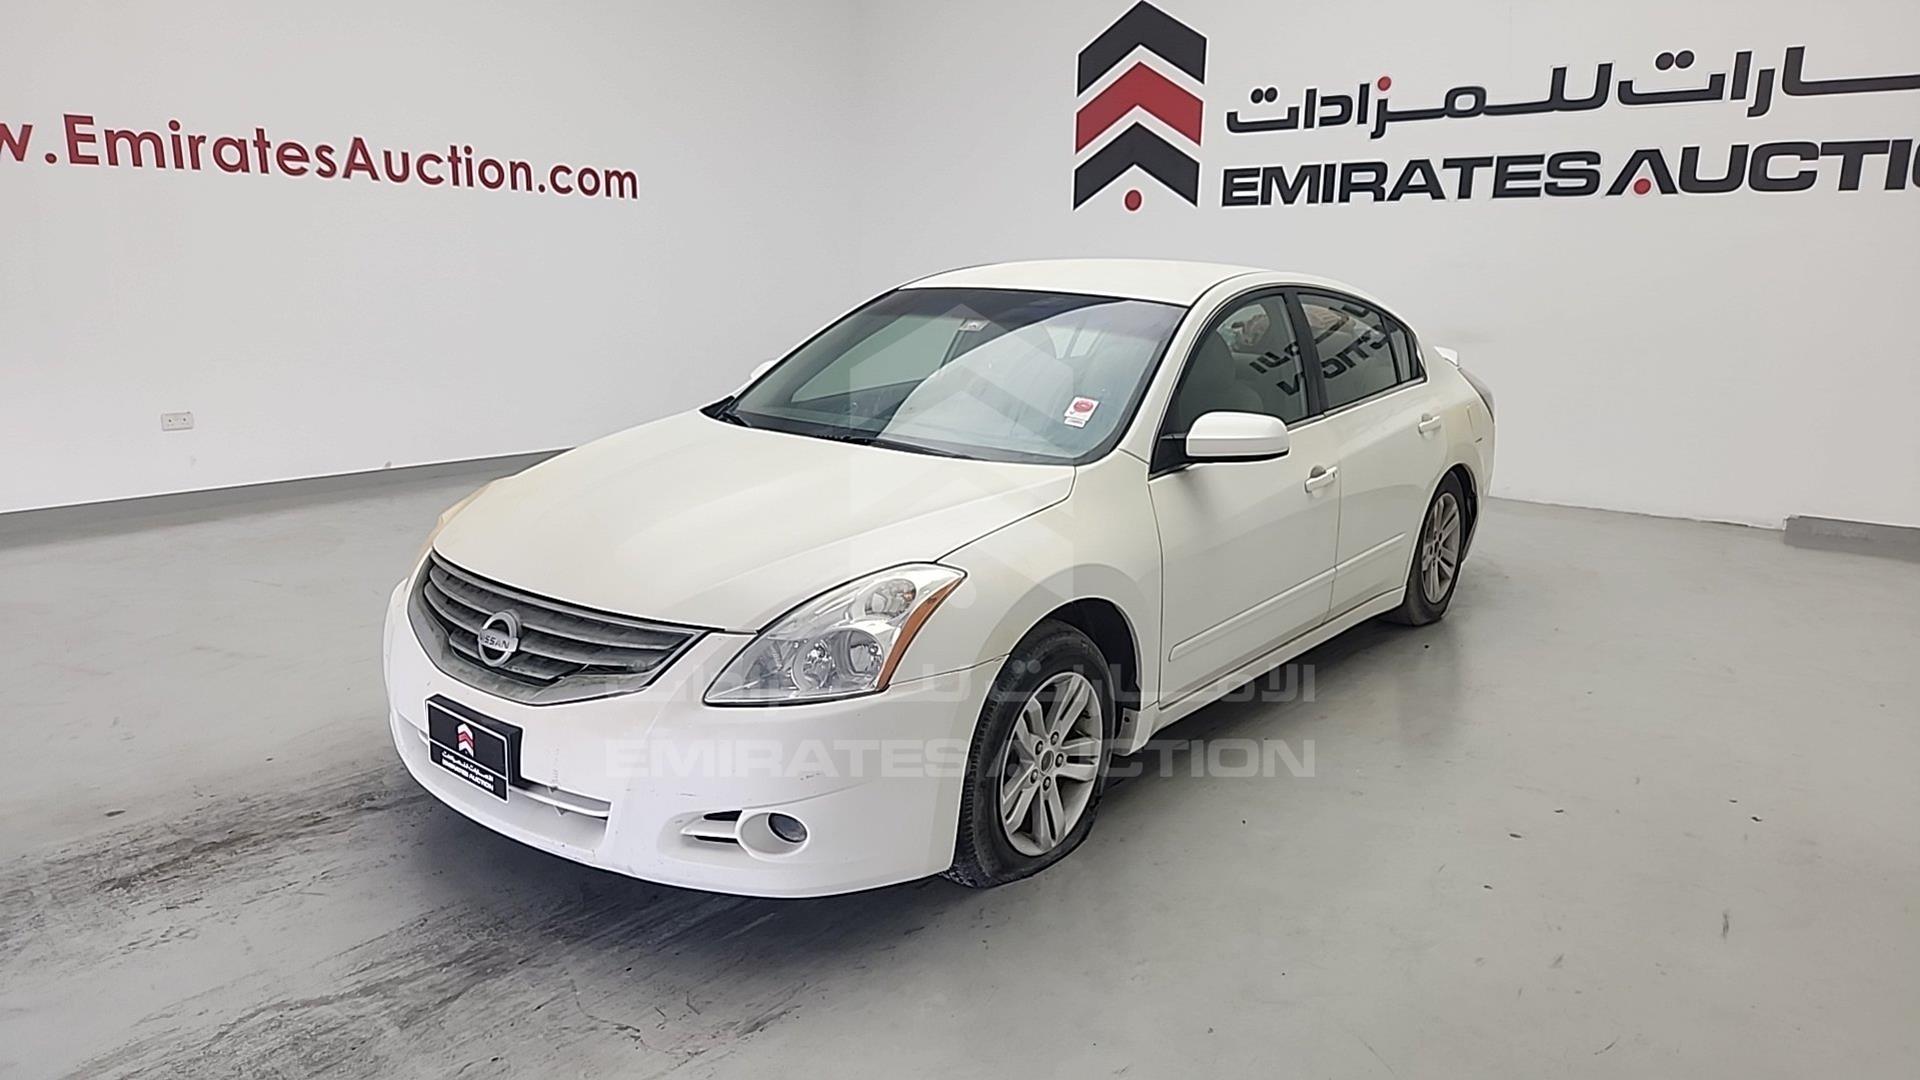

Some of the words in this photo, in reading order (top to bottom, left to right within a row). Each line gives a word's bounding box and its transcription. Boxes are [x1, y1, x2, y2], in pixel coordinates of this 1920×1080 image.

[1226, 62, 1613, 140] للمزادات
[1222, 150, 1601, 206] EMIRATES
[1605, 138, 1920, 196] AUCTI
[479, 631, 510, 650] SSAN
